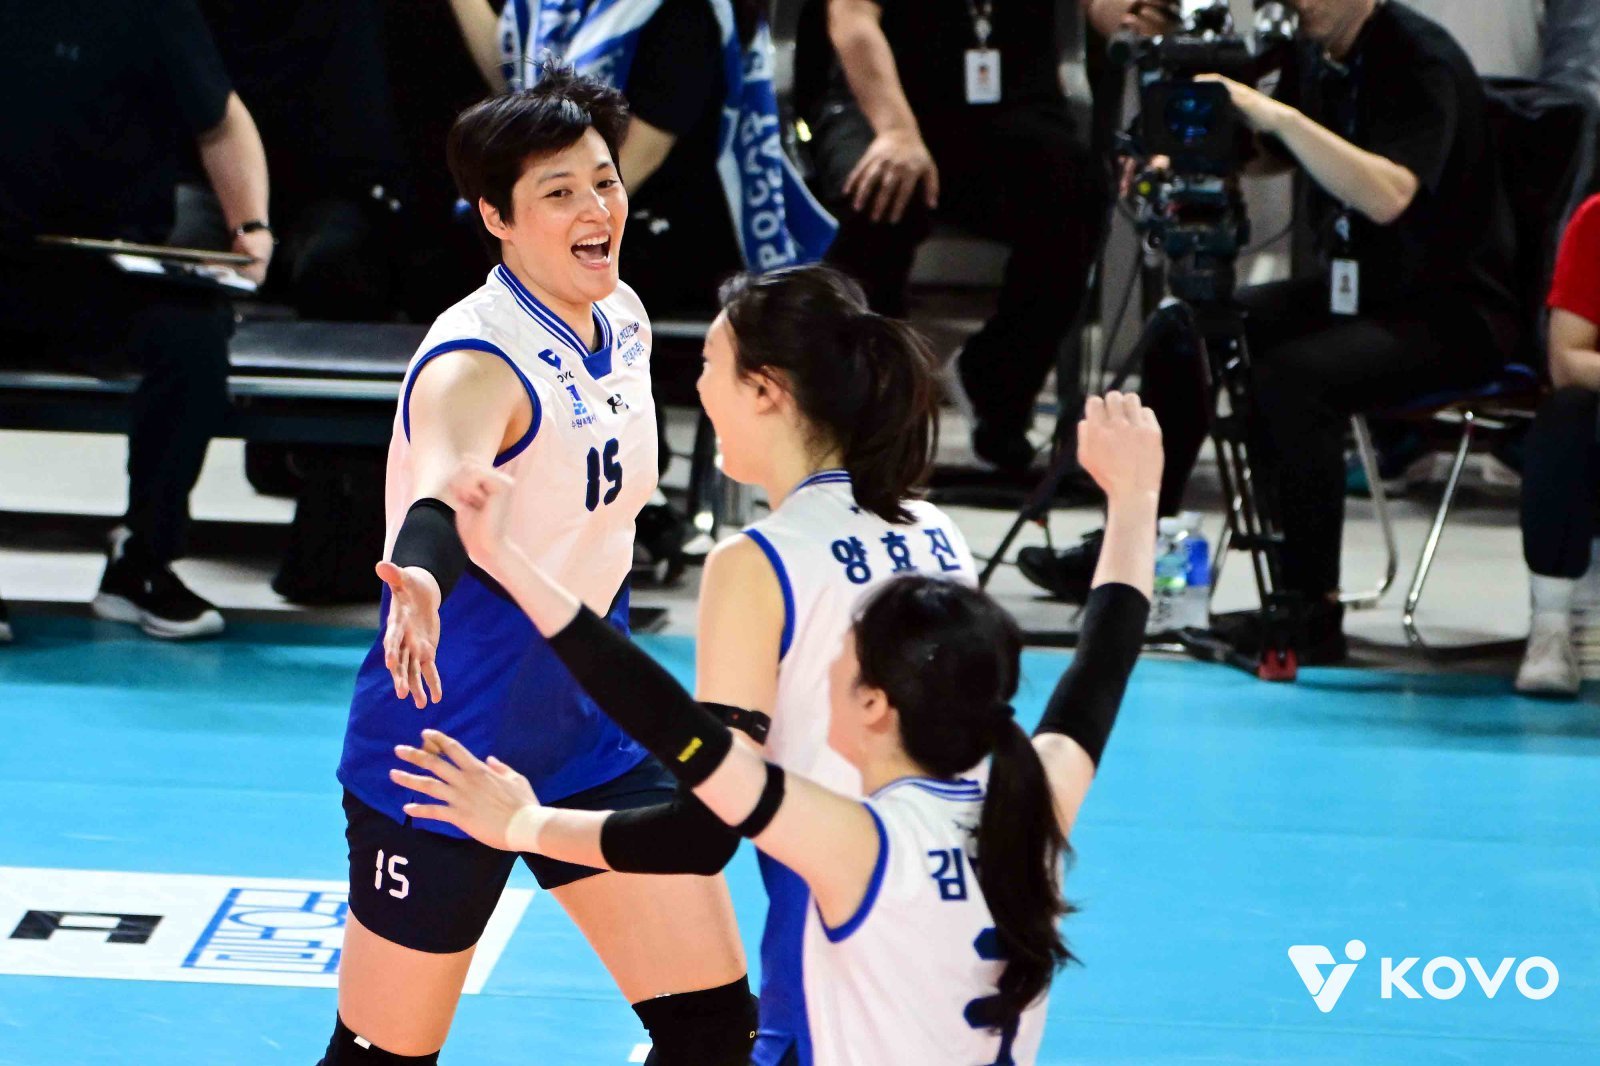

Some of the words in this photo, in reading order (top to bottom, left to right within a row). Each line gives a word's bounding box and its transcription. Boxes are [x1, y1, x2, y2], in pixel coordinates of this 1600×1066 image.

[585, 437, 622, 511] 15
[831, 528, 961, 584] 양효진
[374, 849, 409, 899] 15
[928, 848, 978, 900] 김
